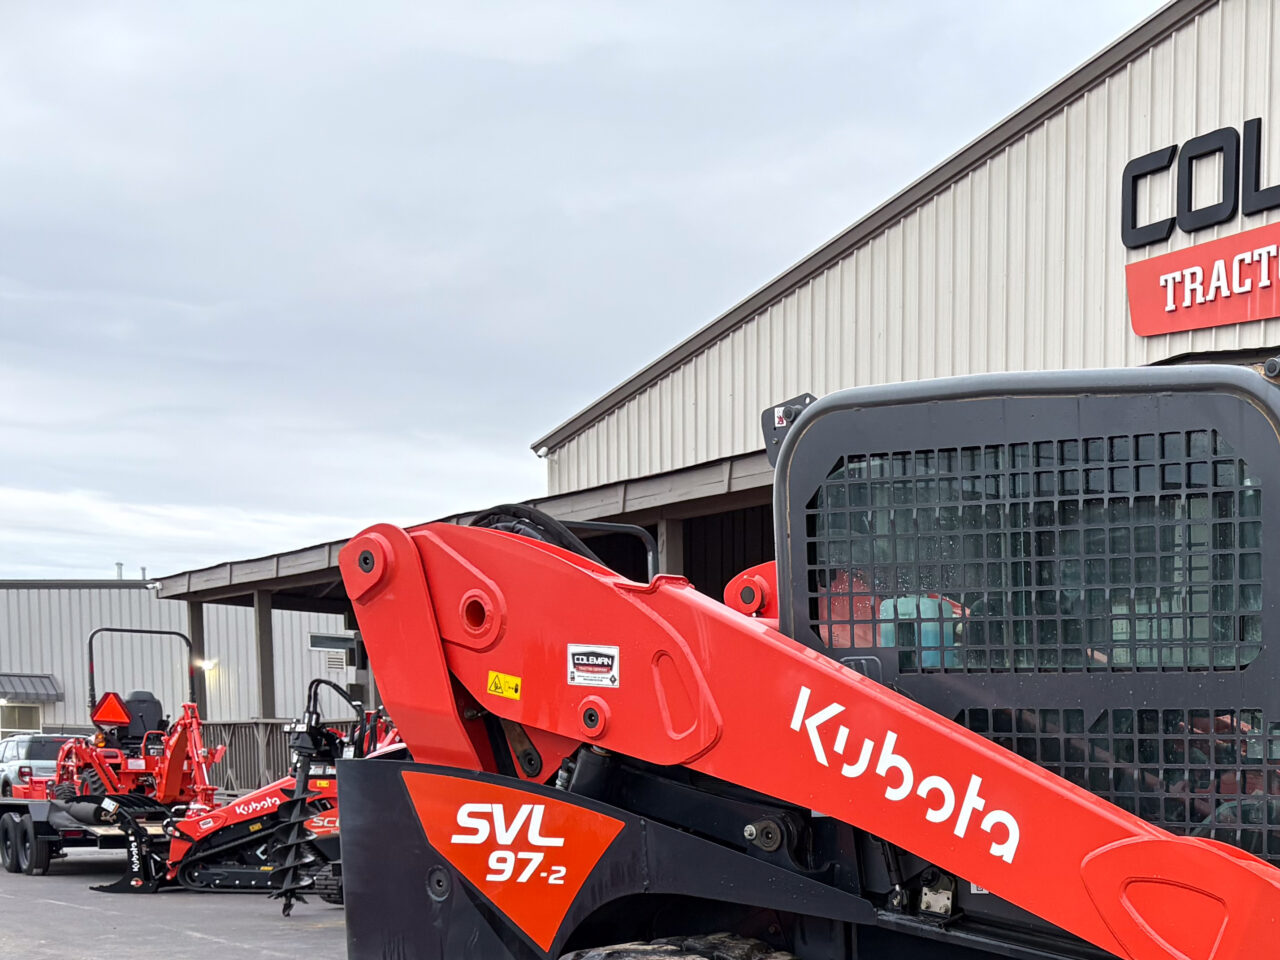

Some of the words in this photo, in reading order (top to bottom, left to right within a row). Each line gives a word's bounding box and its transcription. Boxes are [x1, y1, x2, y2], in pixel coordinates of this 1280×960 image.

[574, 655, 612, 665] COLEMAN
[790, 685, 1020, 864] Kubota
[235, 797, 280, 815] Kubota
[450, 803, 566, 846] SVL
[130, 842, 140, 872] Kubota
[485, 850, 566, 885] 97-2
